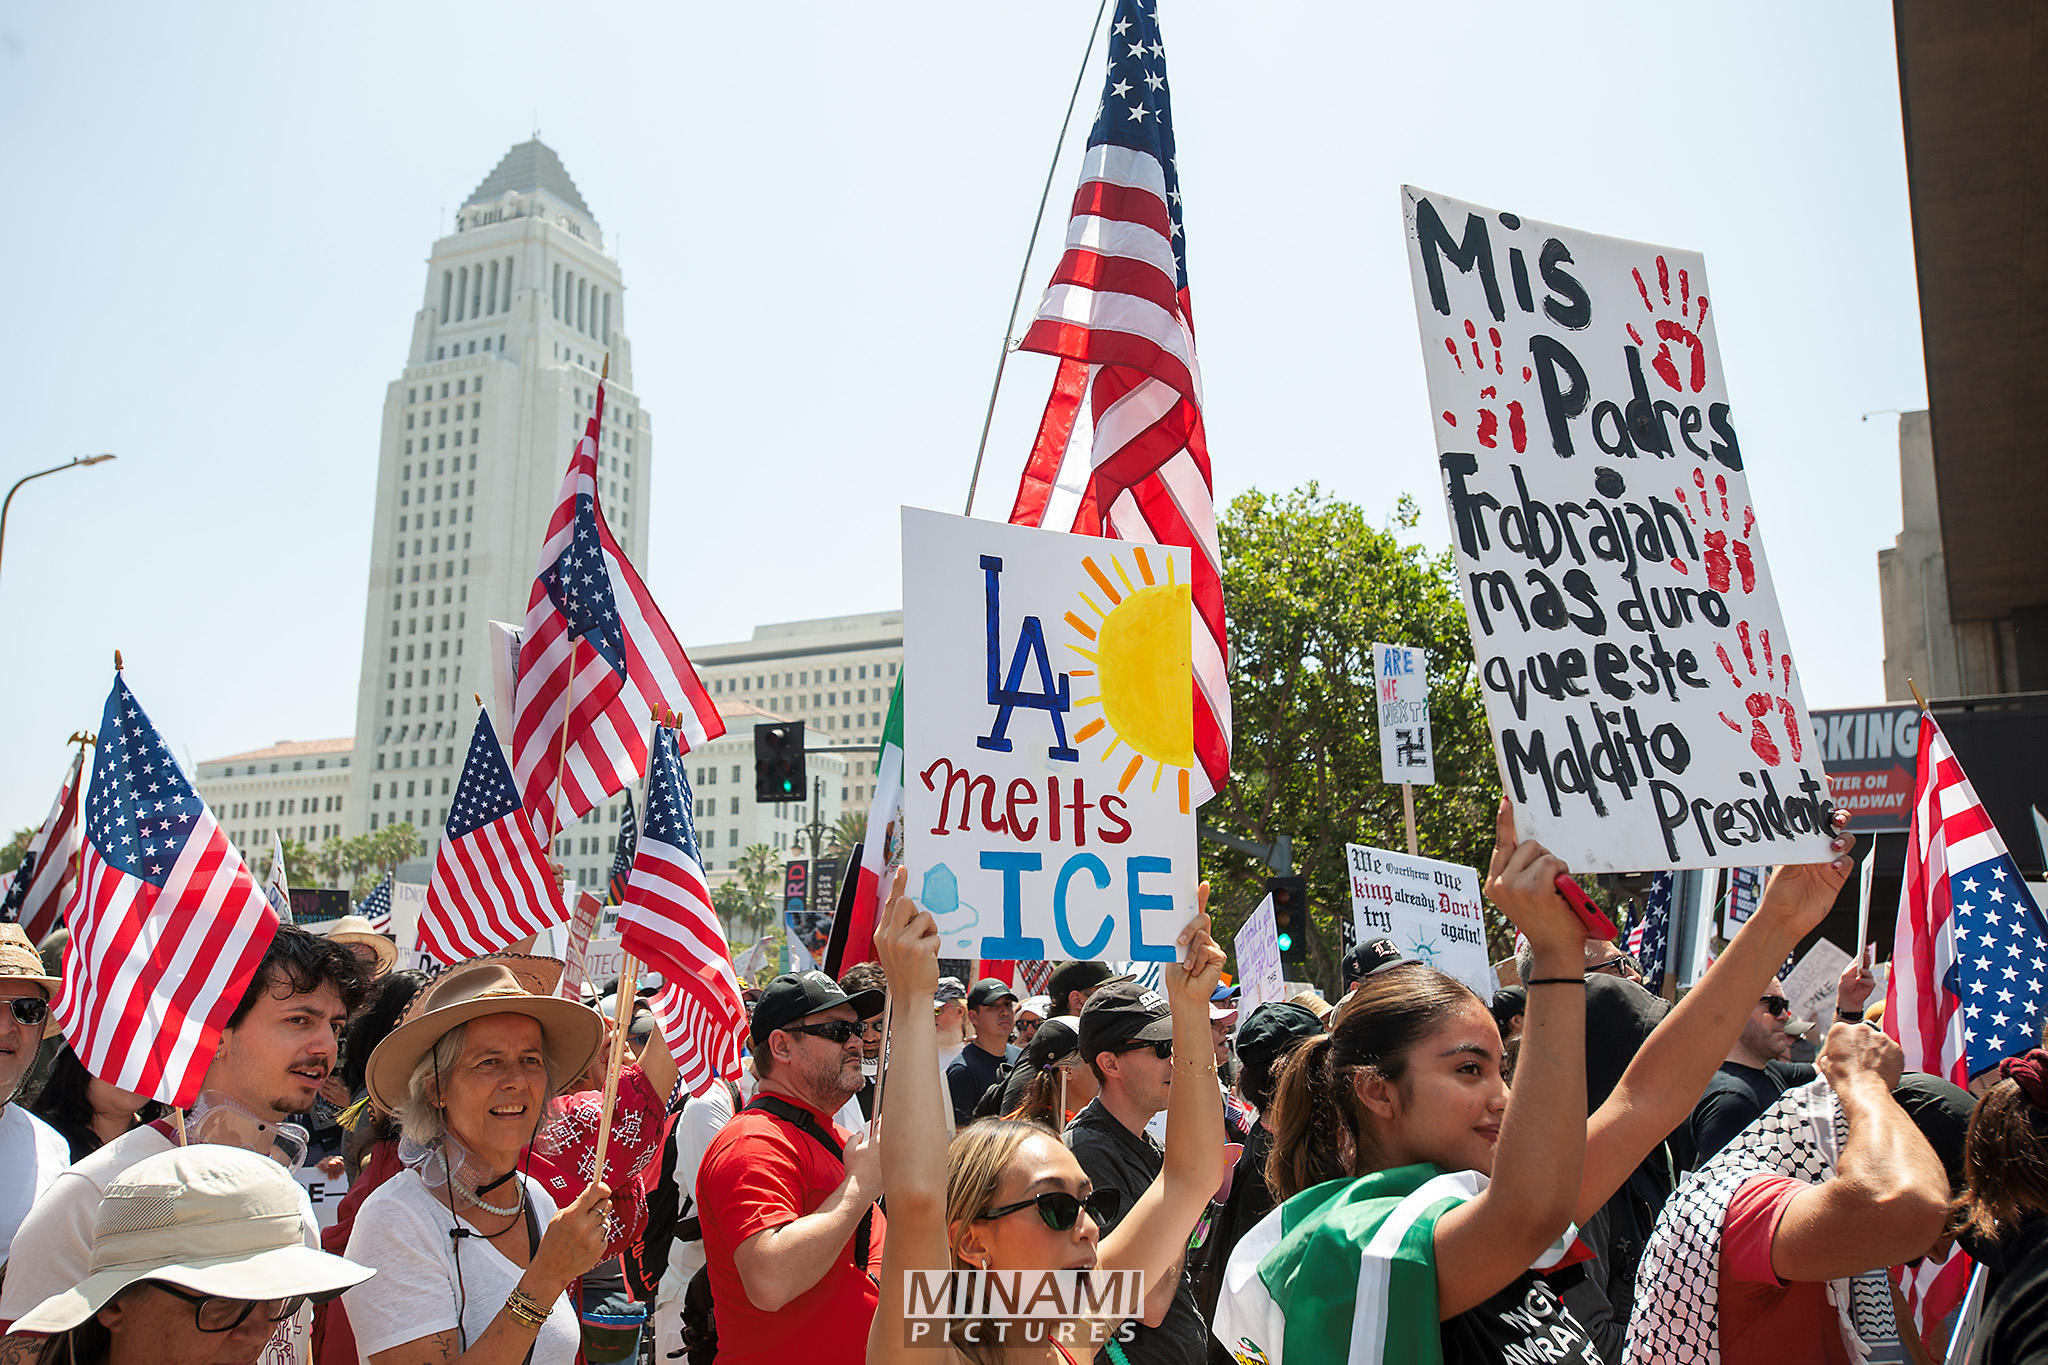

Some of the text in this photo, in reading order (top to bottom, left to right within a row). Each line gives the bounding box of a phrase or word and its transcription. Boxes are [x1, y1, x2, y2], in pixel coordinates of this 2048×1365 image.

[1415, 197, 1592, 332] Mis
[1529, 334, 1745, 472] Padres
[1468, 568, 1731, 637] mas duro
[976, 554, 1079, 762] LA
[1379, 678, 1398, 703] WE
[1383, 648, 1414, 676] ARE
[1501, 701, 1692, 818] Maldito
[1864, 774, 1888, 789] ON
[1649, 768, 1840, 863] Presidente
[1352, 848, 1382, 875] We
[1434, 870, 1463, 891] one
[1353, 876, 1480, 921] king already. Don't
[979, 850, 1178, 963] ICE
[1363, 906, 1482, 945] try again!
